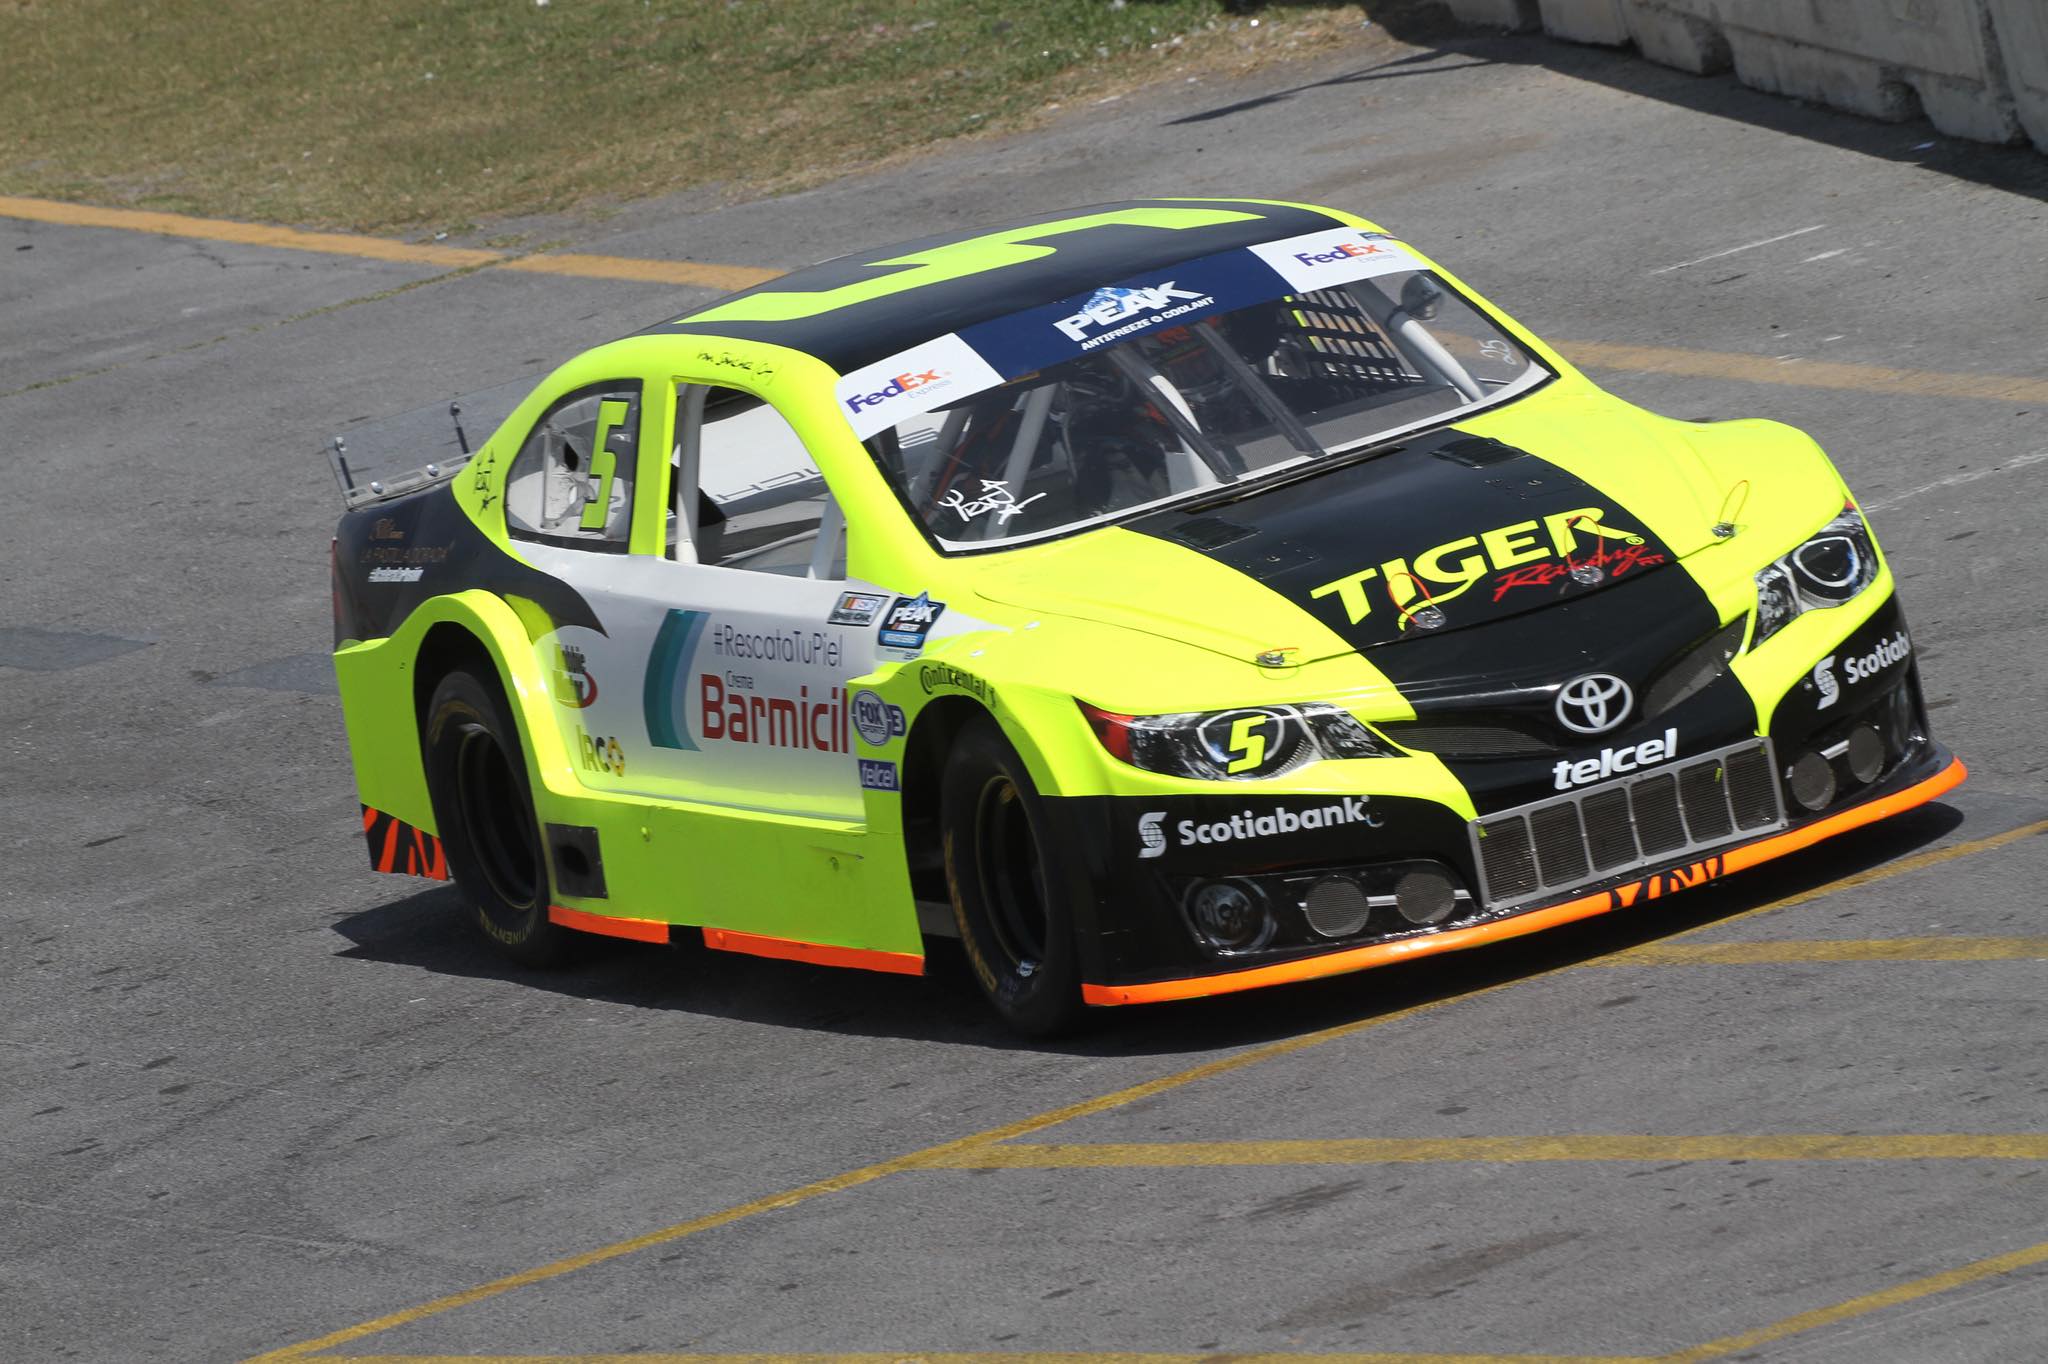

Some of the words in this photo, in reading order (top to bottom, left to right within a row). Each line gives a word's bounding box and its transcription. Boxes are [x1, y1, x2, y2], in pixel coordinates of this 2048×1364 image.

[1292, 243, 1383, 267] FedEx
[1053, 280, 1205, 342] PEAK
[1080, 318, 1152, 351] ANTIFREEZE
[1164, 296, 1215, 319] COOLANT
[845, 368, 942, 414] FedEx
[579, 398, 631, 531] 5
[1309, 507, 1638, 631] TIGER
[888, 606, 938, 625] PEAK
[713, 623, 843, 668] #RescataTuPiel
[725, 670, 753, 690] Crema
[700, 673, 849, 754] Barmicil
[858, 701, 885, 727] FOX
[1227, 715, 1267, 774] 5
[1552, 727, 1678, 791] telcel
[861, 762, 895, 788] telcel
[1177, 796, 1367, 846] Scotiabank
